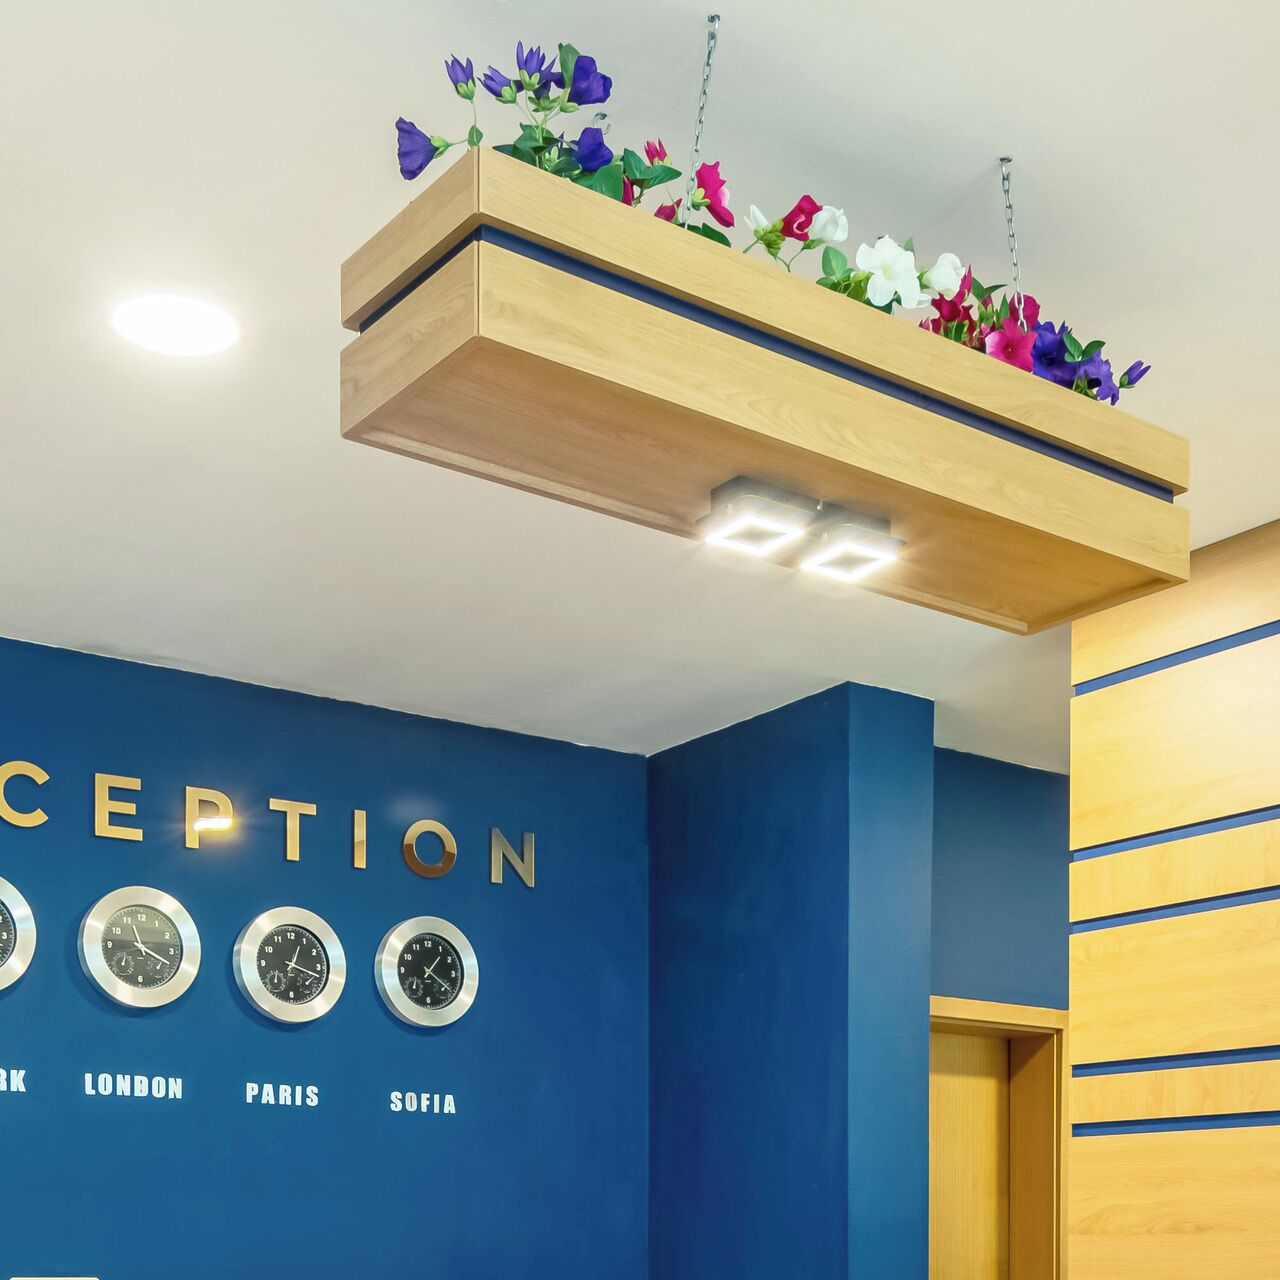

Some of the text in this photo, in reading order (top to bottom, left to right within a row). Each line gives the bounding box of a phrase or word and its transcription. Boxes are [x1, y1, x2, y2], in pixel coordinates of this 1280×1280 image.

[137, 914, 146, 922] 12
[112, 927, 121, 935] 10
[84, 1073, 183, 1099] LONDON
[246, 1082, 319, 1106] PARIS
[390, 1091, 456, 1114] SOFIA
